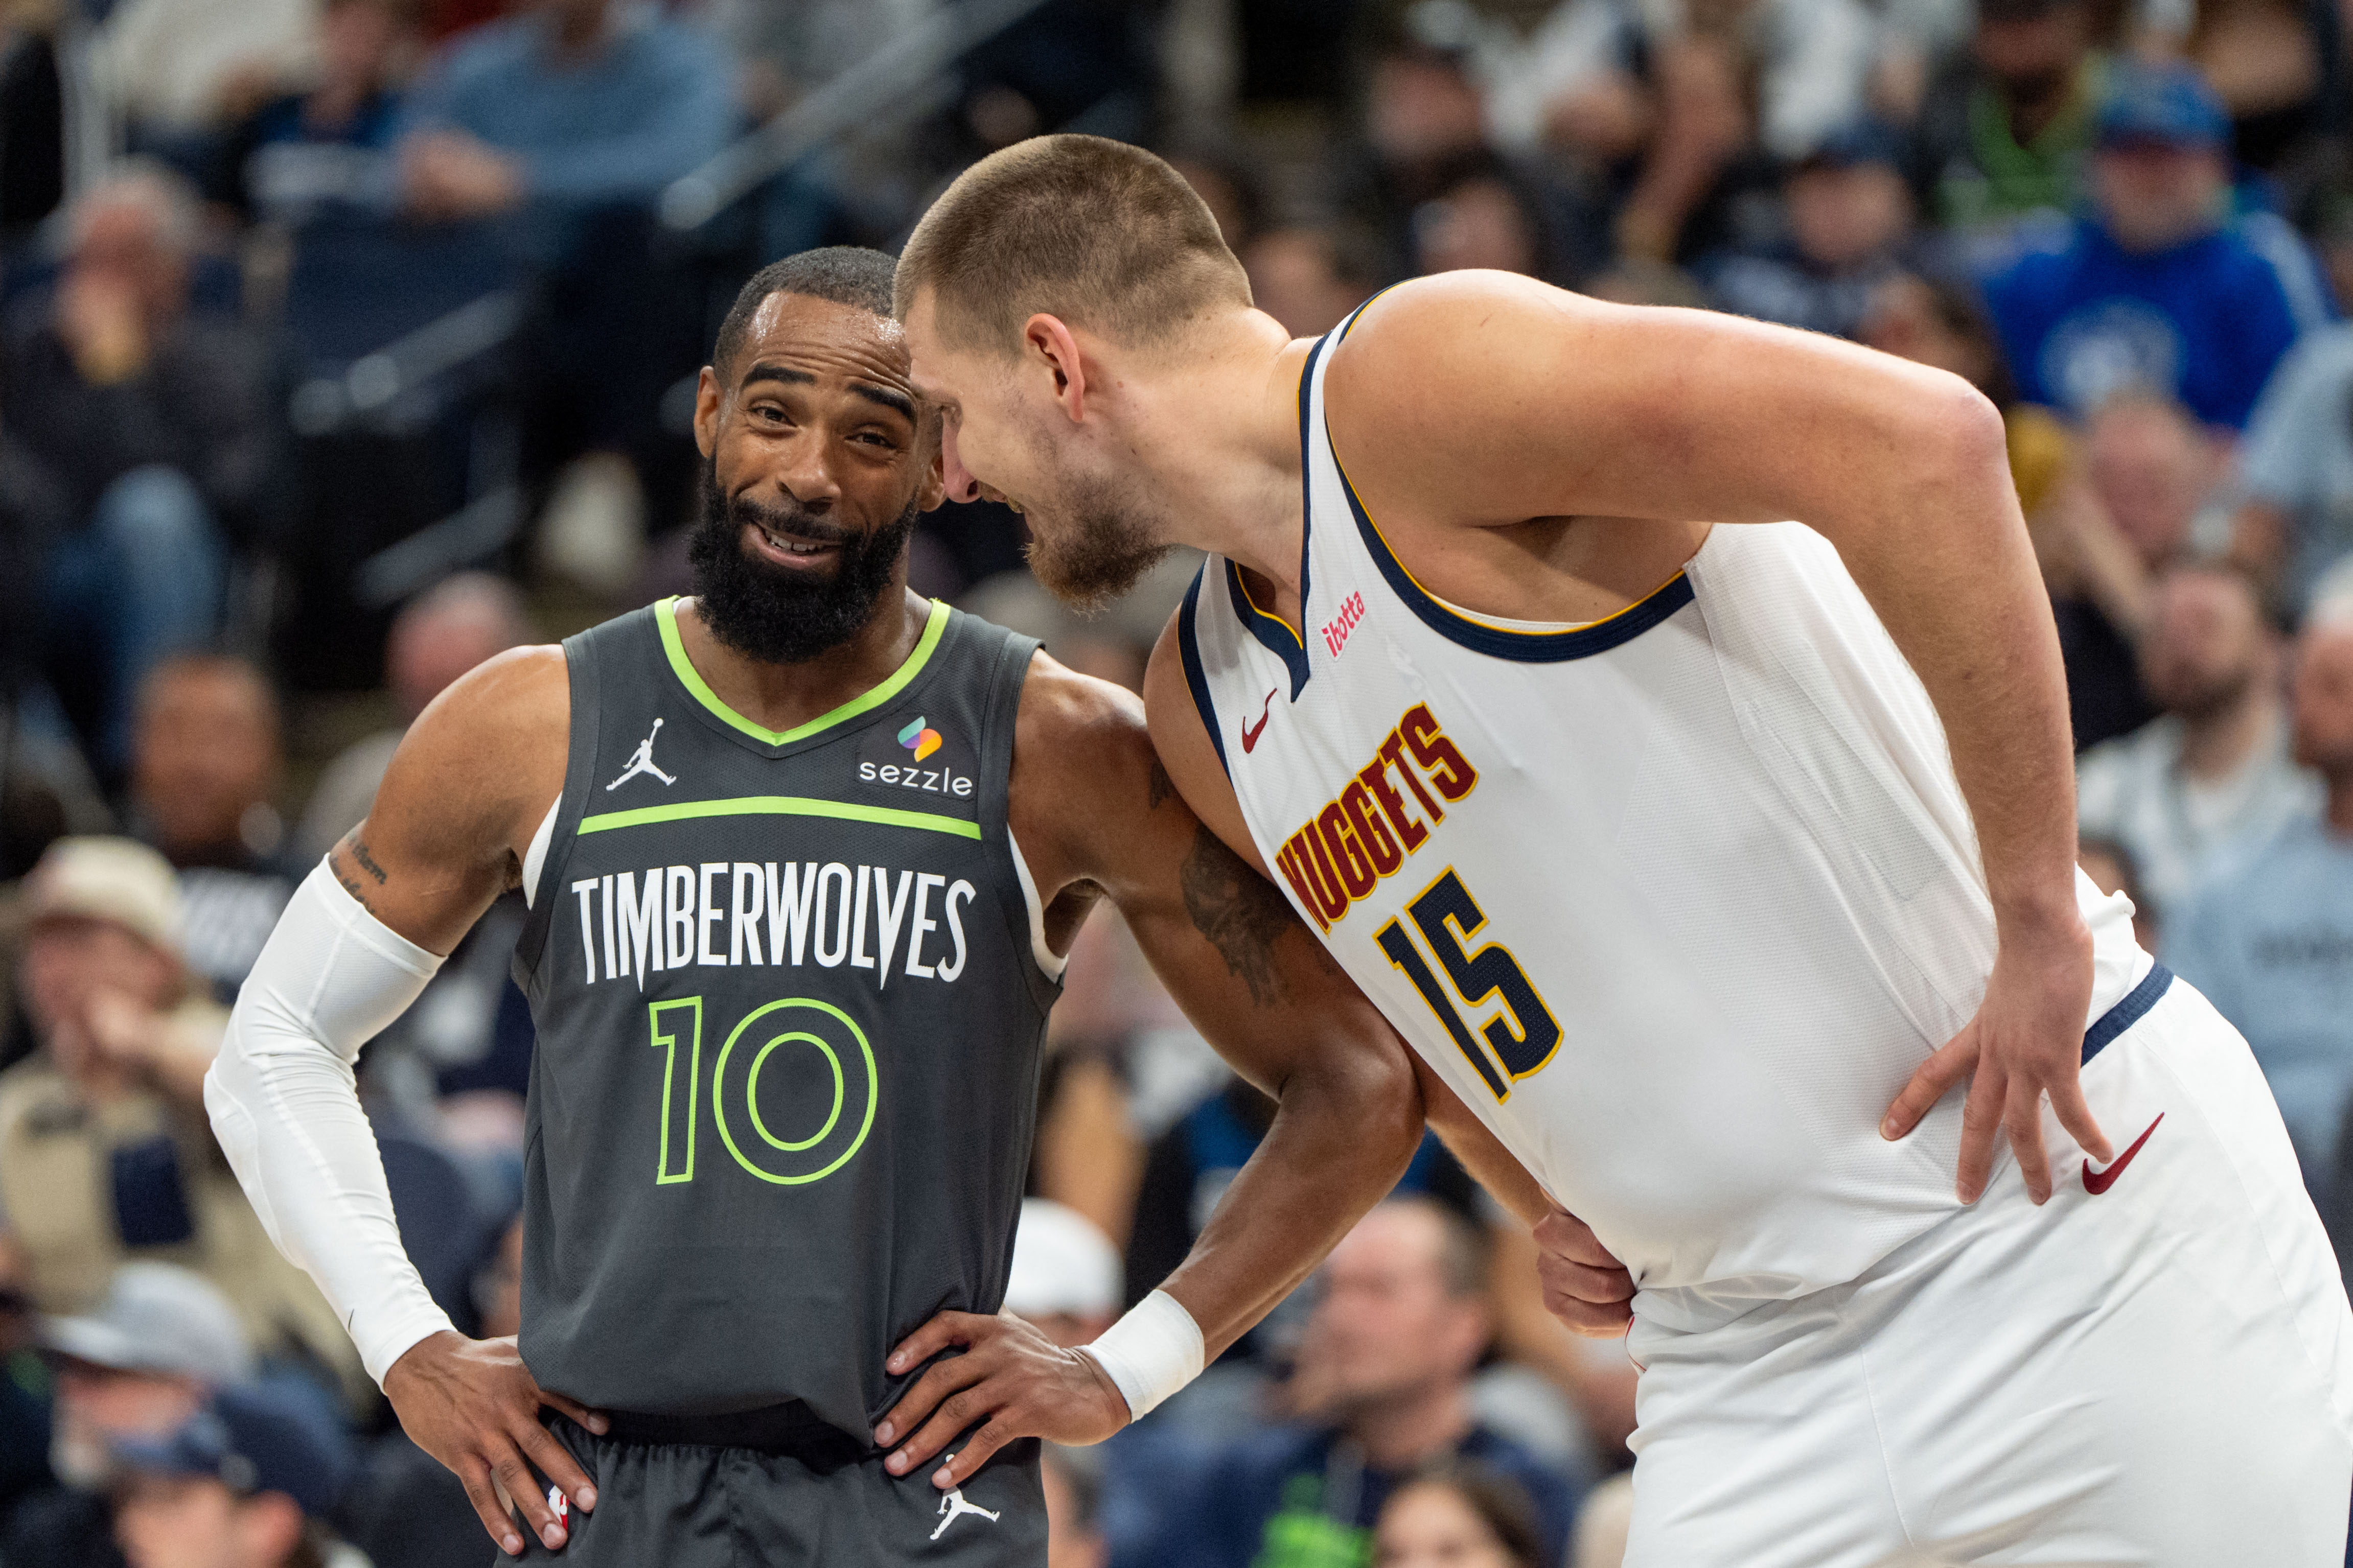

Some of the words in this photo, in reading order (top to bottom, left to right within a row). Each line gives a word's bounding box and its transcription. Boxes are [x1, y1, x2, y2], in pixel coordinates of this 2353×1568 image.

[1321, 591, 1365, 658] ibotta
[860, 762, 973, 795] sezzle
[1275, 700, 1479, 940] NUGGETS
[572, 862, 976, 992] TIMBERWOLVES
[1372, 863, 1564, 1105] 15
[649, 995, 878, 1185] 10
